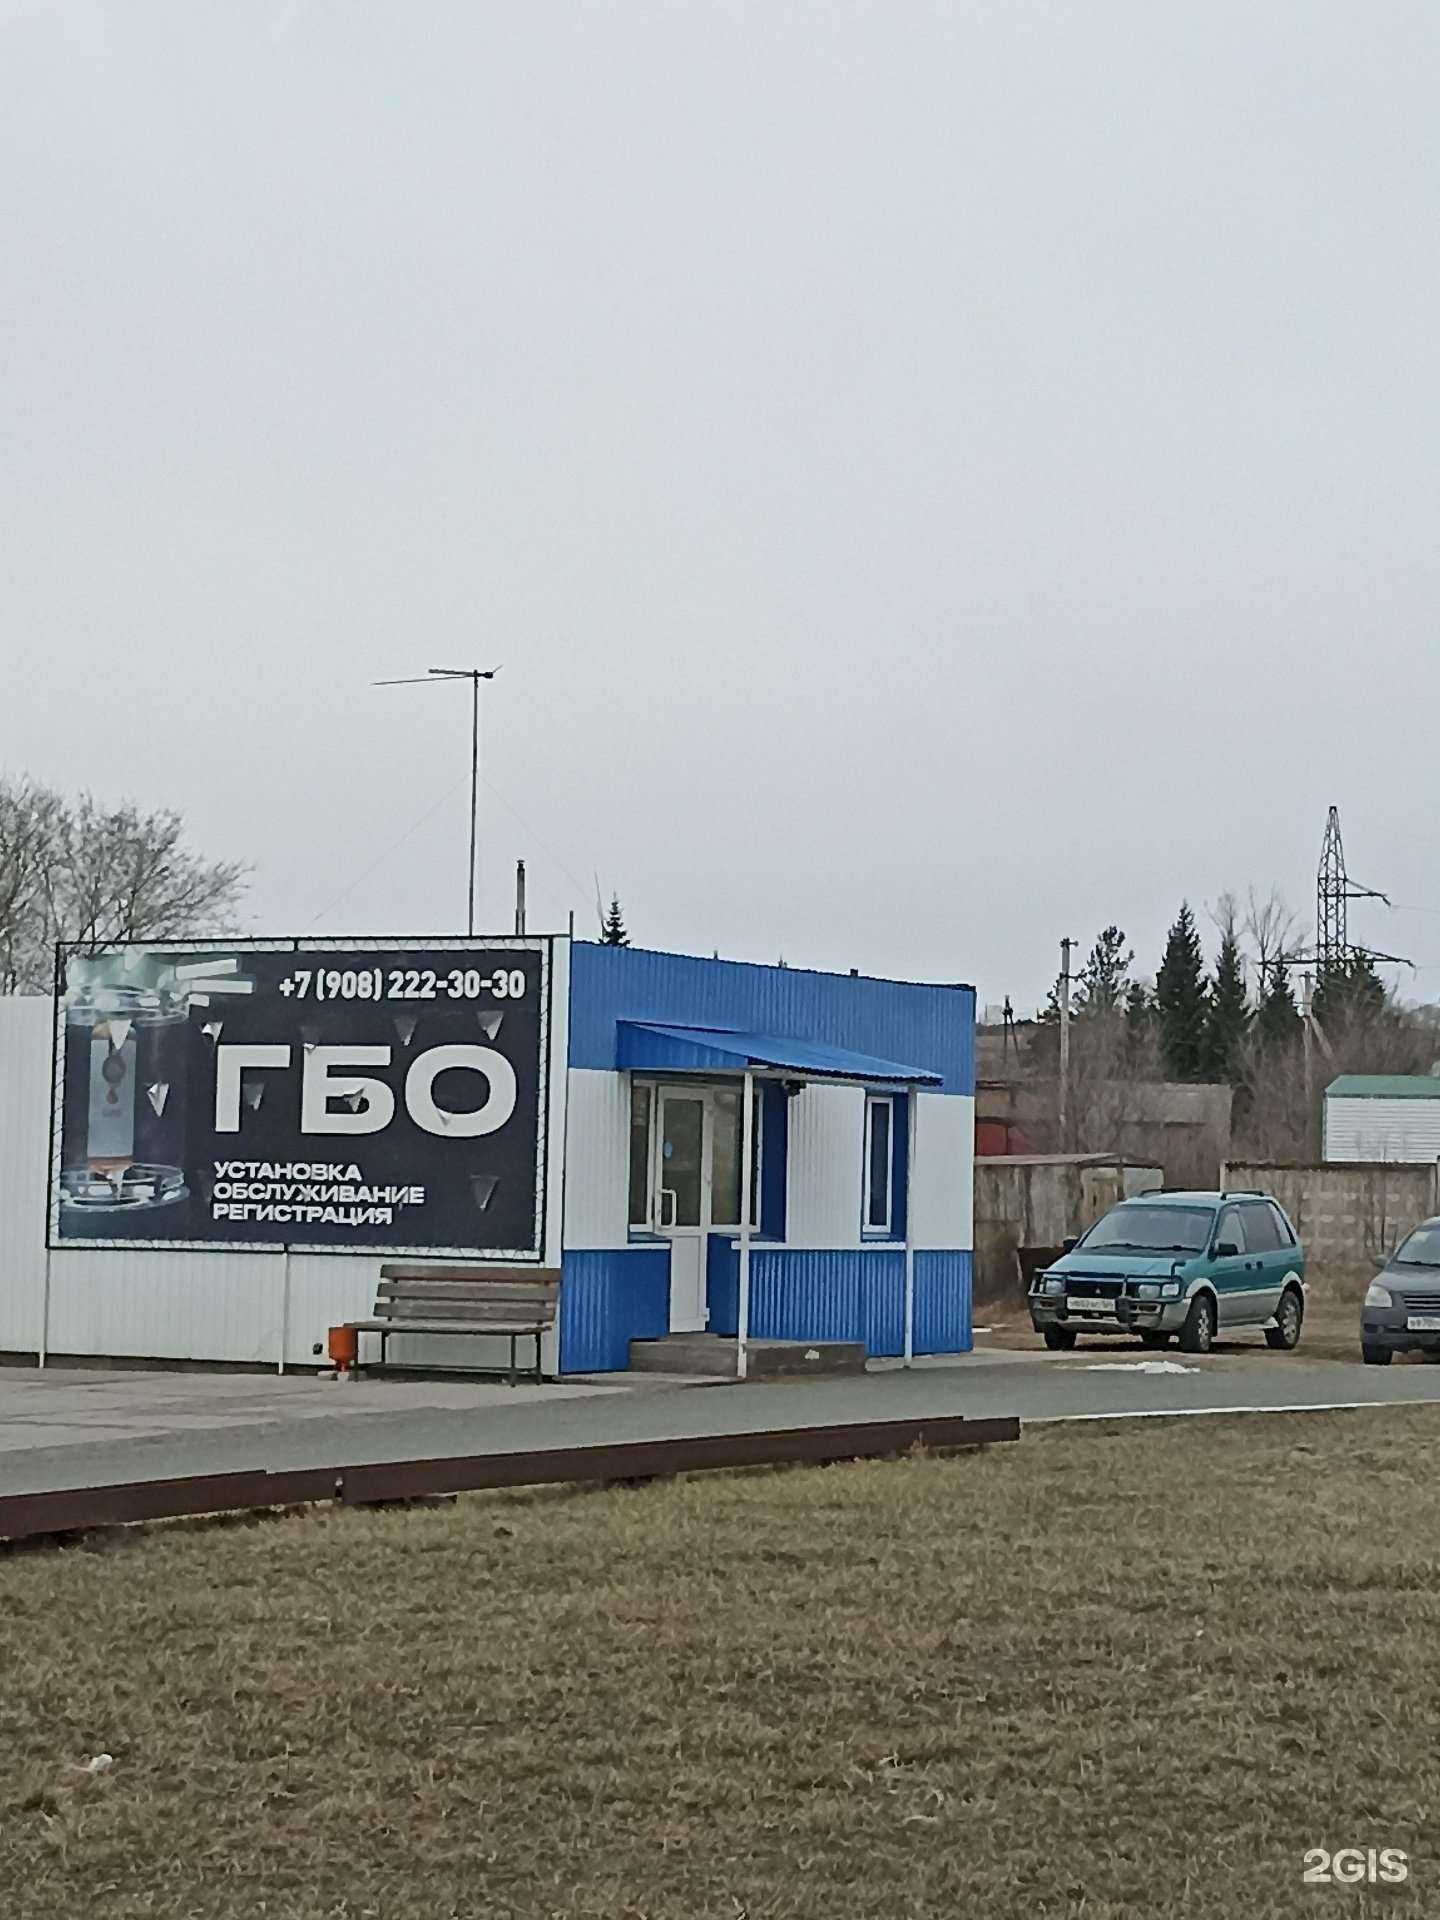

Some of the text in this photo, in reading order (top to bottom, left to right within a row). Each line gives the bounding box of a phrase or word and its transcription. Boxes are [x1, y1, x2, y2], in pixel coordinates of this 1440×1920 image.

[279, 968, 525, 1001] +7 (908) 222-30-30
[214, 1043, 517, 1138] ГБО
[213, 1162, 362, 1182] УСТАНОВКА
[213, 1183, 425, 1204] ОБСЛУЖИВАНИЕ
[212, 1203, 392, 1225] РЕГИСТРАЦИЯ
